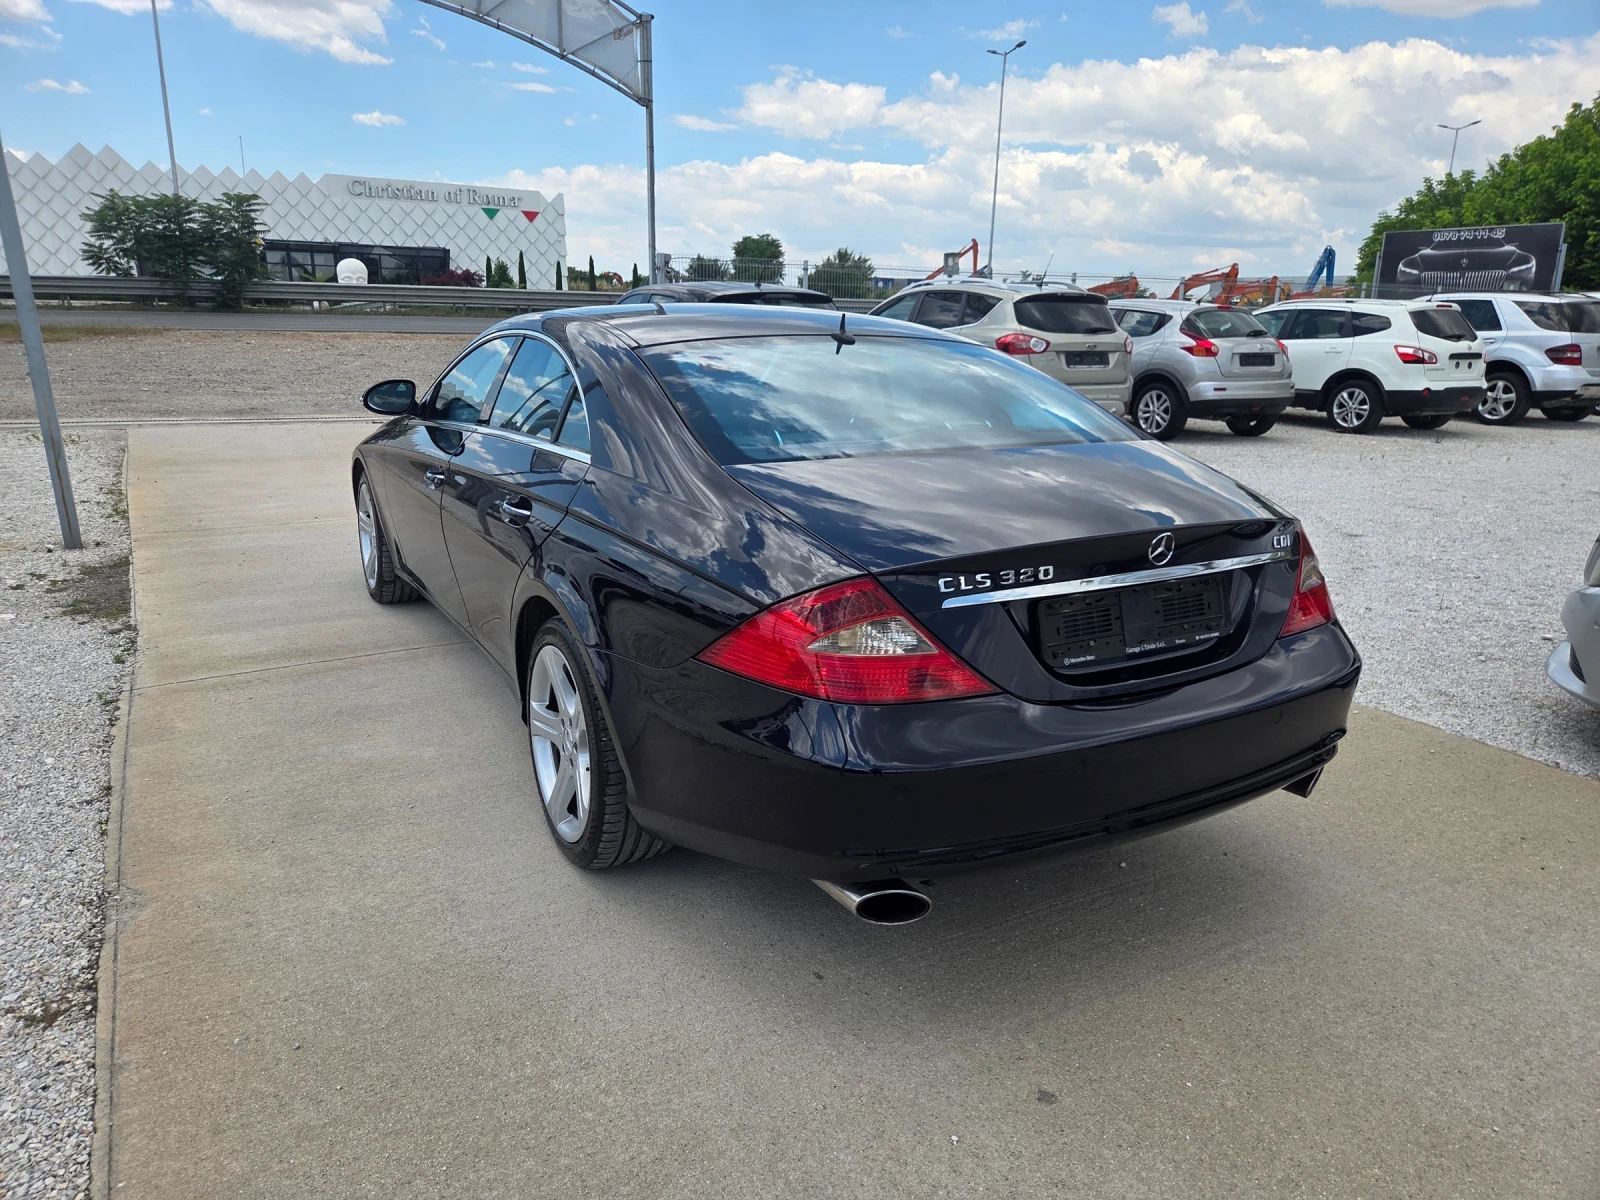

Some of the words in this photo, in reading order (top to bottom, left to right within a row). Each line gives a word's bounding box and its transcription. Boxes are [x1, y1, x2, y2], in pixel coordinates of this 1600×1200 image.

[347, 180, 438, 202] Christian
[444, 188, 463, 205] of
[467, 188, 520, 208] Roma
[1432, 227, 1506, 241] 0878-74-11-45
[1273, 534, 1291, 549] CDI
[938, 573, 992, 593] CLS
[999, 565, 1054, 585] 320
